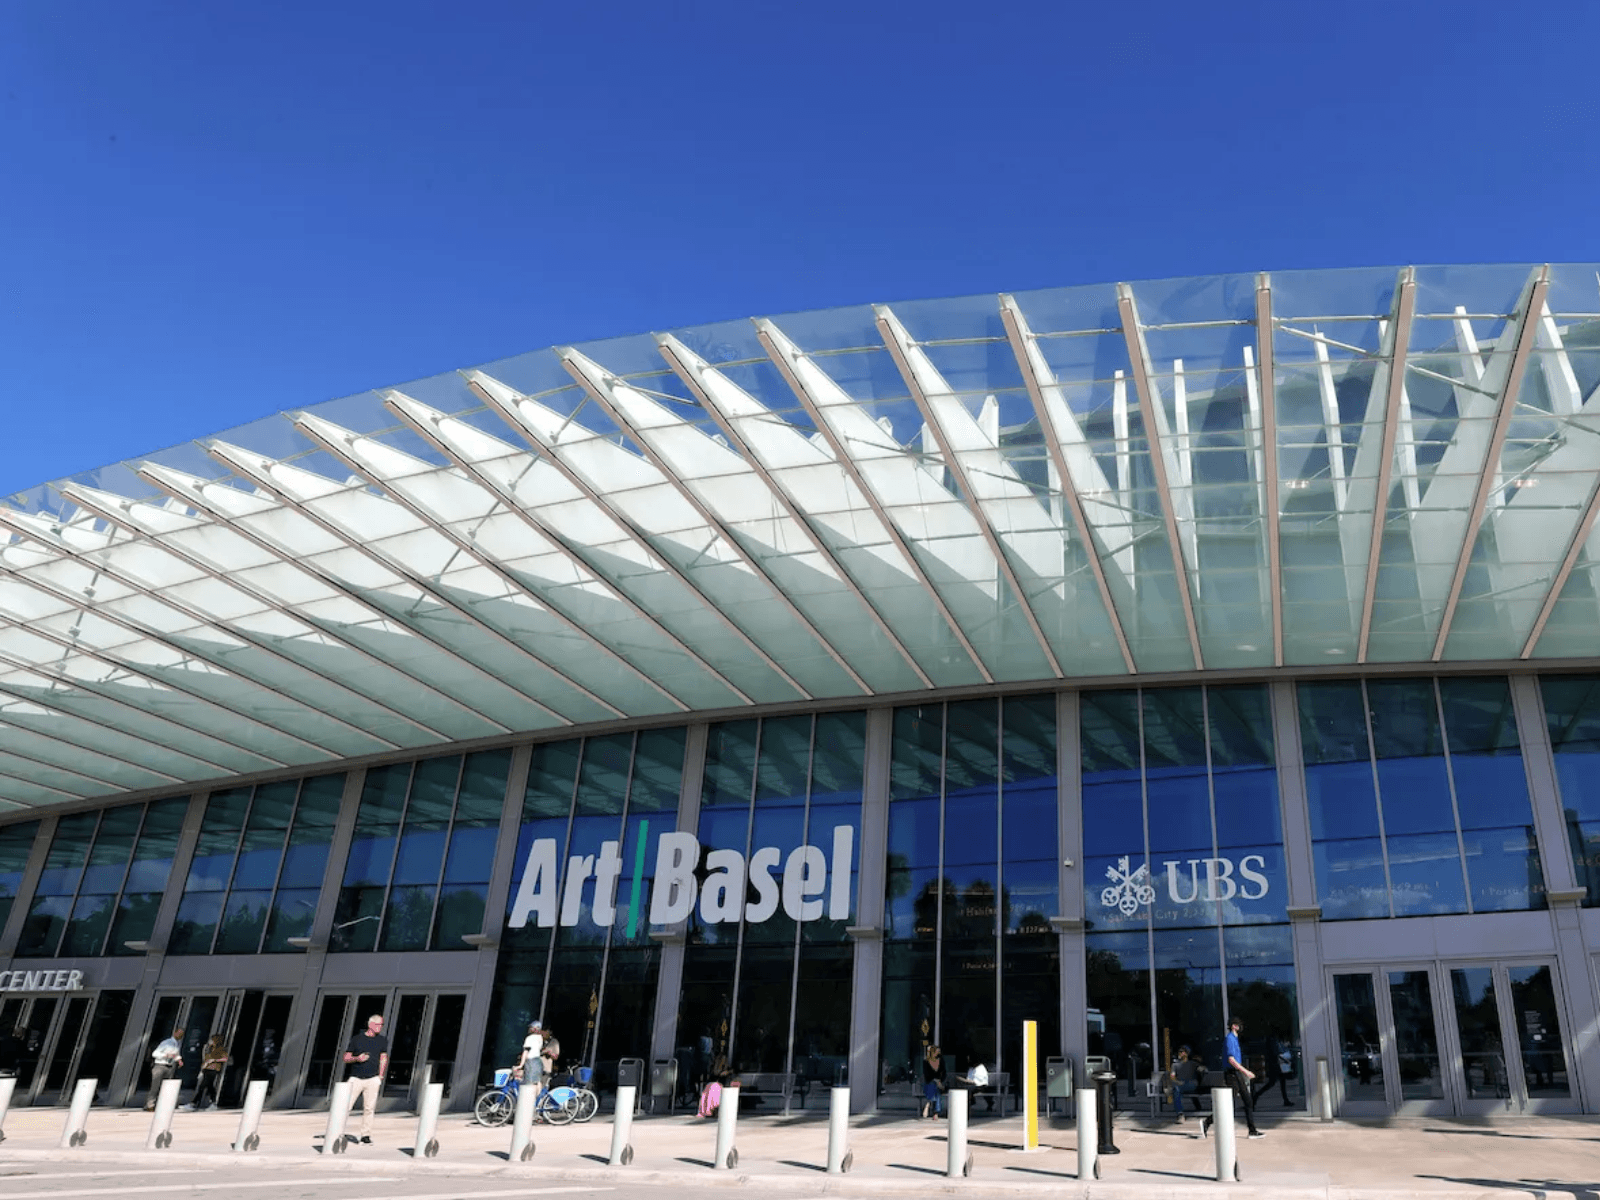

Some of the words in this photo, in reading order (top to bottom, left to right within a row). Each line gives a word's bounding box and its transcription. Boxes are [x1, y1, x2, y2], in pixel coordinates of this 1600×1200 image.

[508, 838, 622, 928] Art
[649, 825, 853, 925] Basel
[1163, 855, 1269, 904] UBS
[0, 970, 83, 991] CENTER
